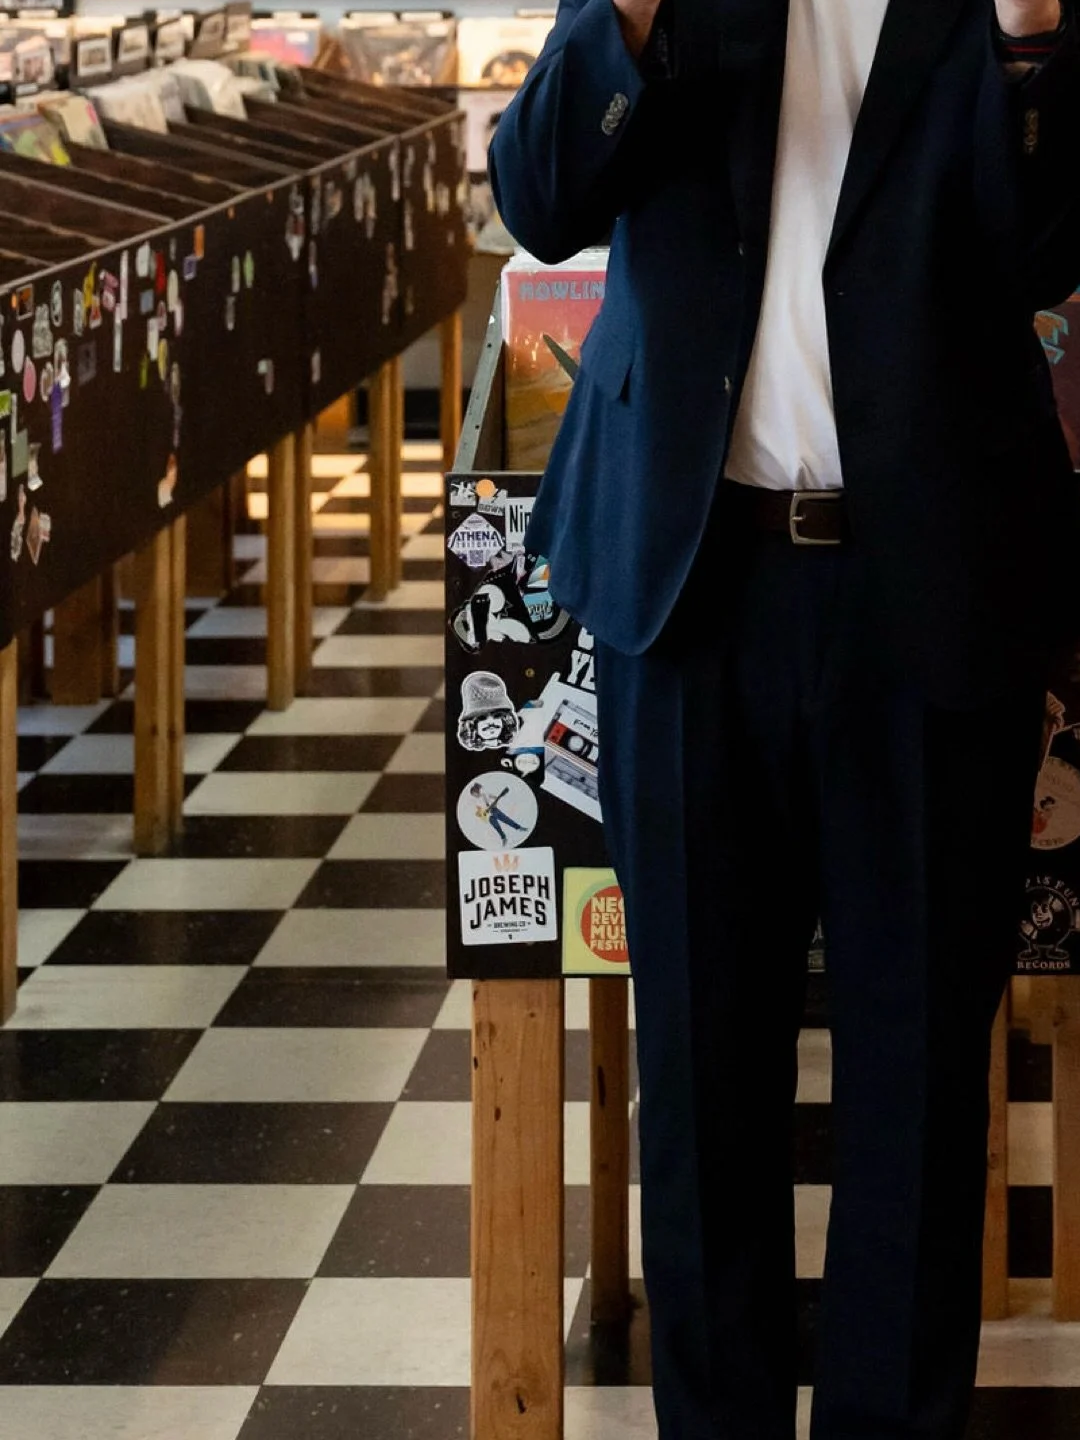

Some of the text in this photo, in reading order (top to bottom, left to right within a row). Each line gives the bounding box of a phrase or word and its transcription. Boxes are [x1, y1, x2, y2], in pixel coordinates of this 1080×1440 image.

[450, 531, 503, 548] ATHENA
[464, 874, 550, 904] JOSEPH
[470, 896, 547, 930] JAMES
[1016, 959, 1072, 969] RECORDS
